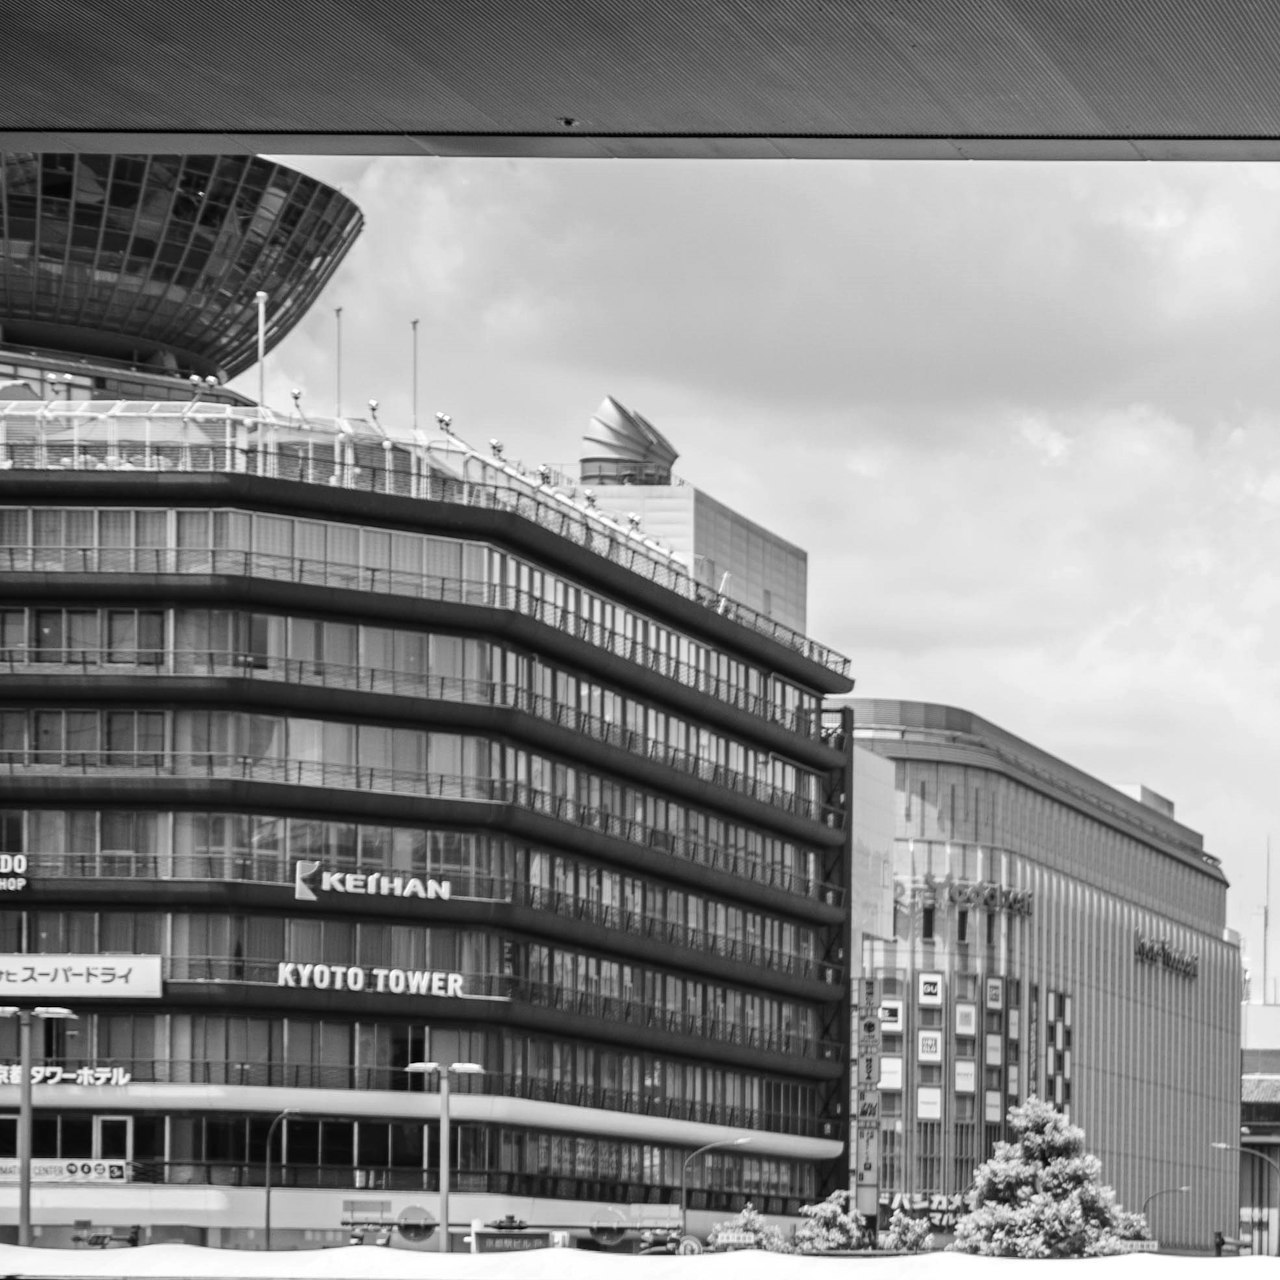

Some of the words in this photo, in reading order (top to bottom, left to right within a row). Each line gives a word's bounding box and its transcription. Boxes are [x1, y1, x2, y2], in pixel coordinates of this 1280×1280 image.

[321, 871, 451, 900] KEIHAN
[278, 962, 364, 991] KYOTO
[372, 967, 465, 998] TOWER
